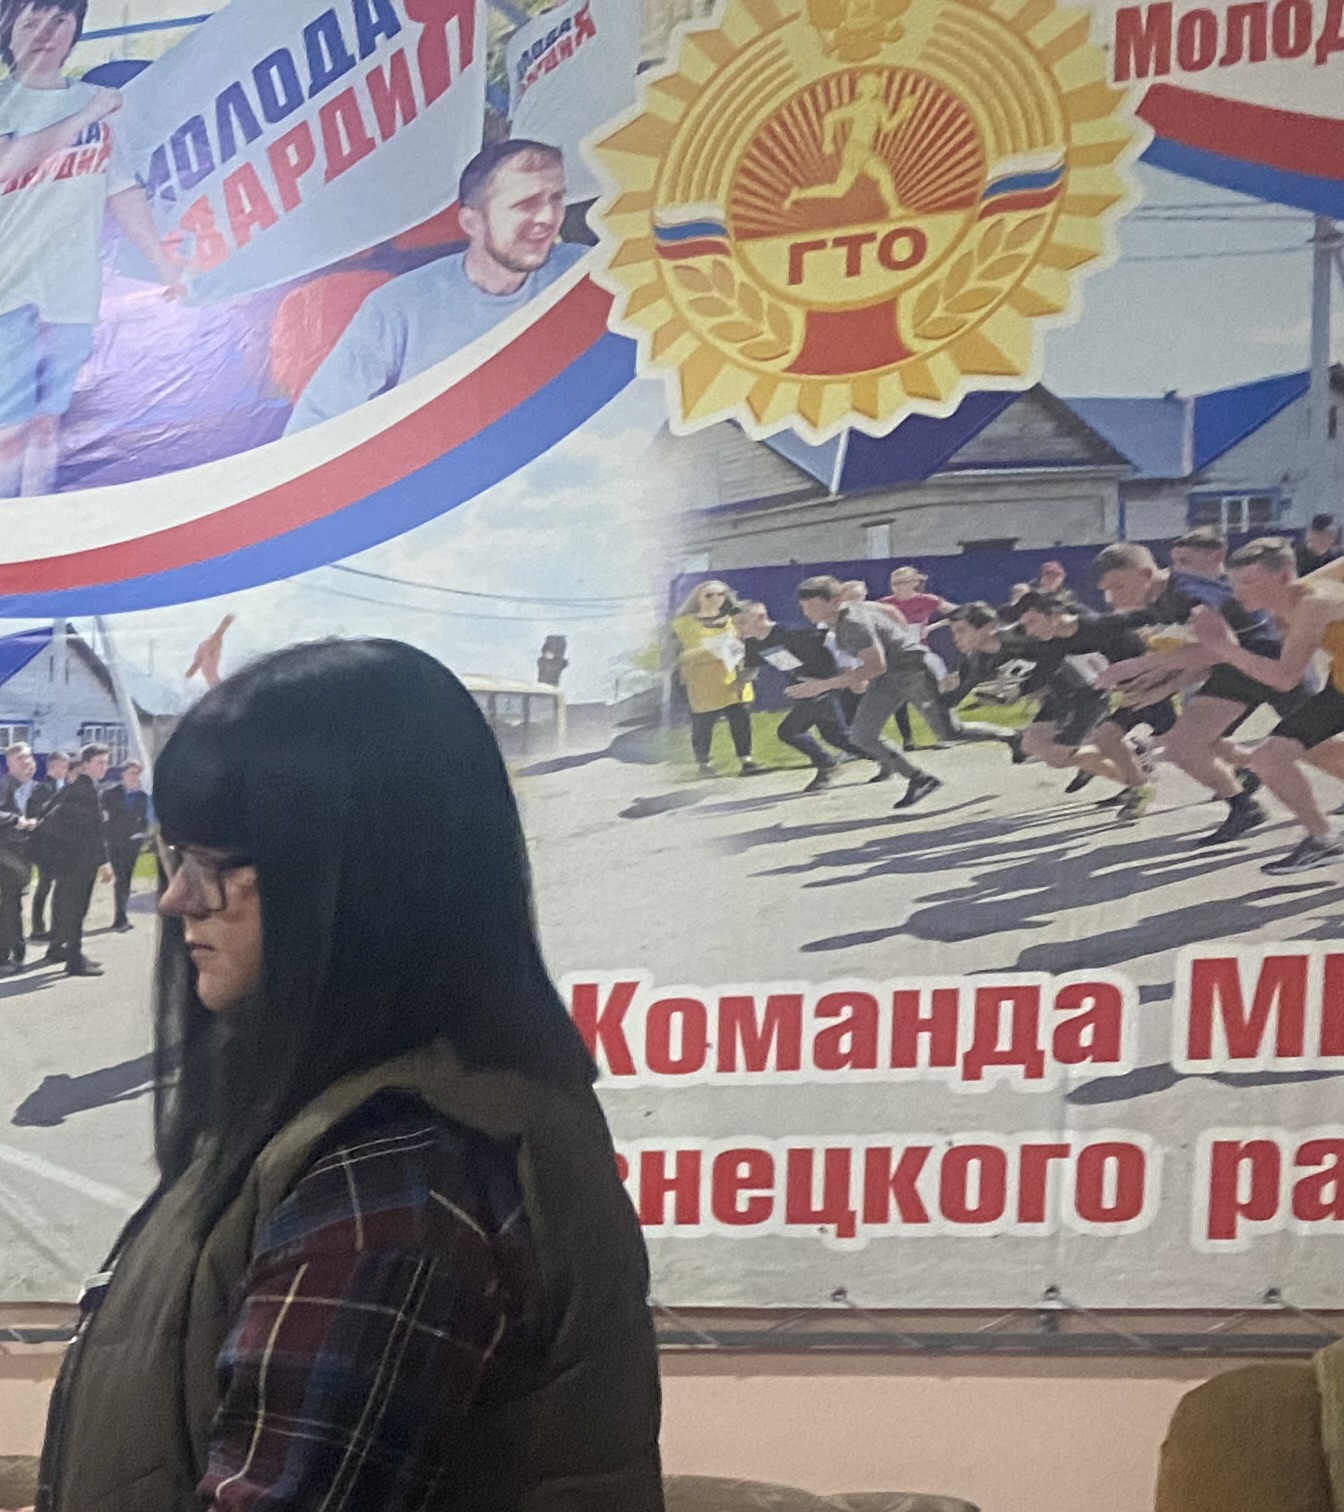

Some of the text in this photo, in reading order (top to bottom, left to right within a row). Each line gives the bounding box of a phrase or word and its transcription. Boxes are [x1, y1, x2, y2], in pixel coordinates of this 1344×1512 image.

[788, 226, 927, 286] ГТО
[571, 980, 1122, 1081] Команда
[616, 1141, 1146, 1239] нецкого
